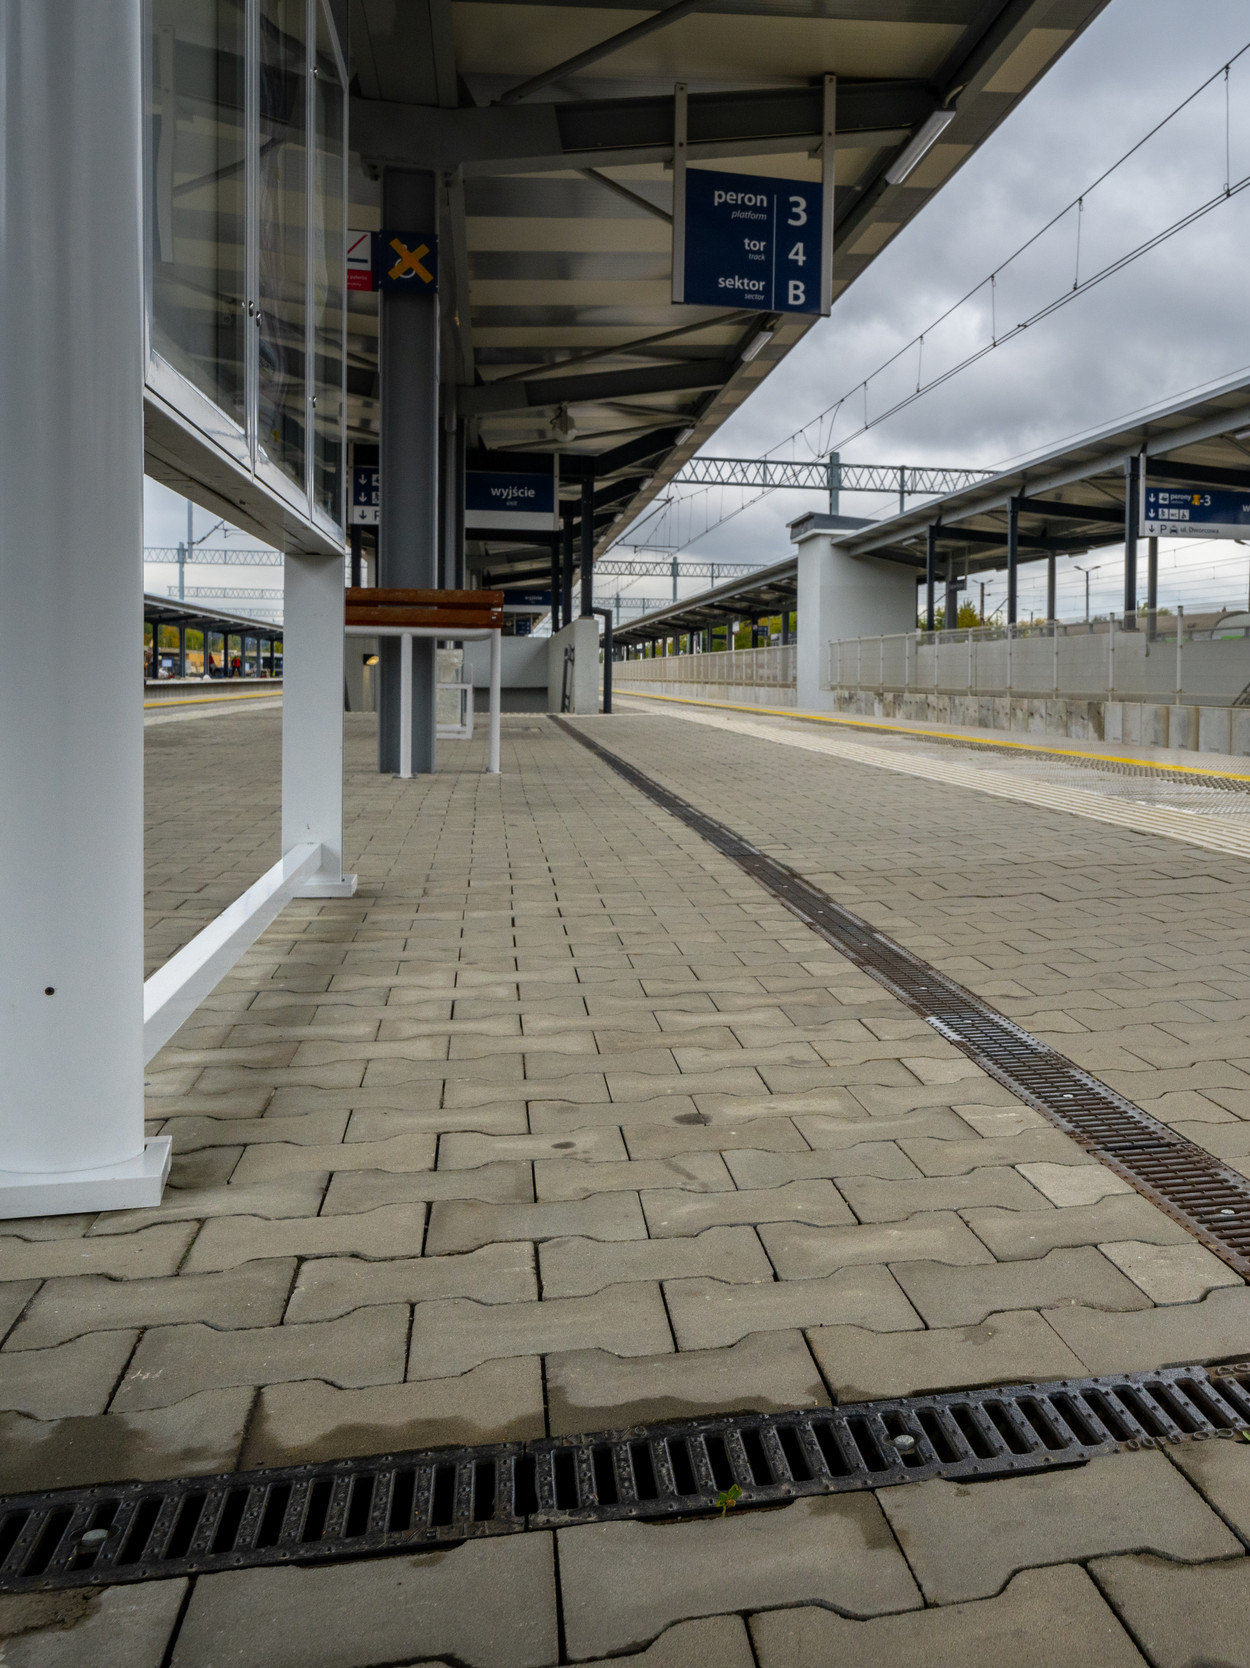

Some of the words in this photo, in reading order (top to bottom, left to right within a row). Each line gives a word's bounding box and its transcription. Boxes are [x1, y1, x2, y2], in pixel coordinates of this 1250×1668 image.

[714, 190, 767, 207] peron
[787, 196, 808, 226] 3
[731, 210, 767, 221] platform
[744, 238, 766, 251] tor
[788, 242, 806, 266] 4
[748, 253, 765, 261] track
[718, 275, 765, 291] sektor
[788, 280, 806, 305] B
[491, 486, 535, 499] wyjście
[1170, 494, 1191, 502] perony
